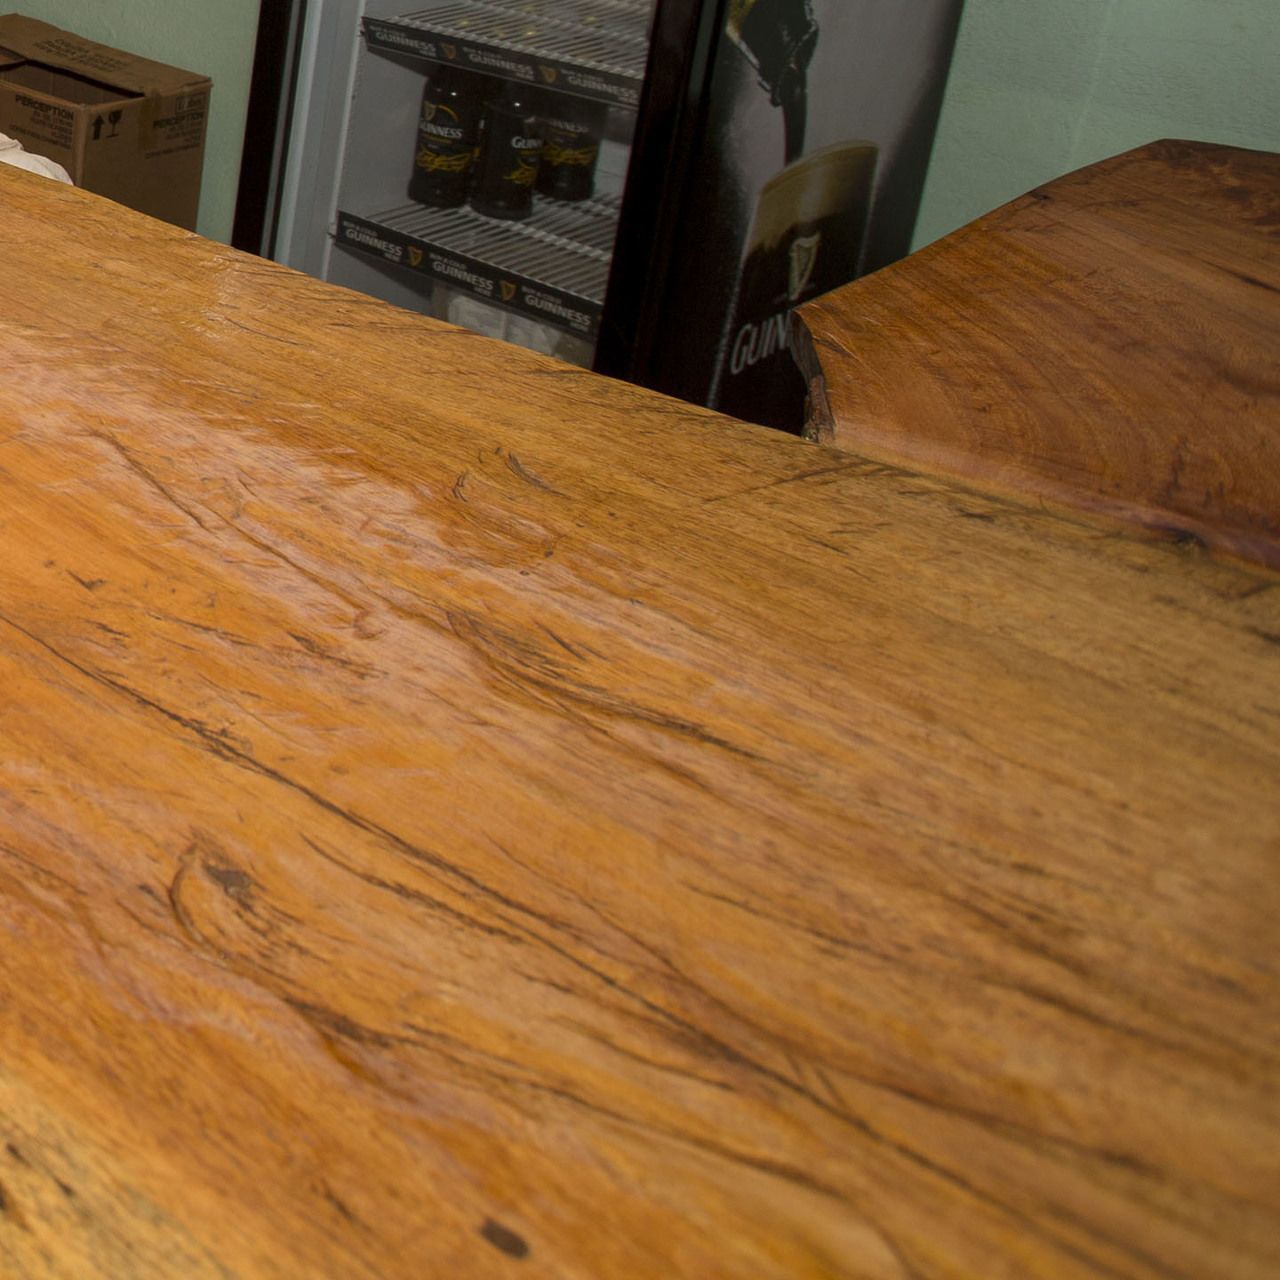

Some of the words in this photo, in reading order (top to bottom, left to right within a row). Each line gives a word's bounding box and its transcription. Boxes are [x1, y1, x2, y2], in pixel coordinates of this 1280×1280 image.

[375, 31, 437, 53] GUINNESS
[468, 52, 535, 75] GUINNESS
[16, 94, 74, 121] PERCEPTION
[345, 227, 403, 258] GUINNESS
[432, 260, 494, 291] GUINNESS
[524, 293, 591, 327] GUINNESS
